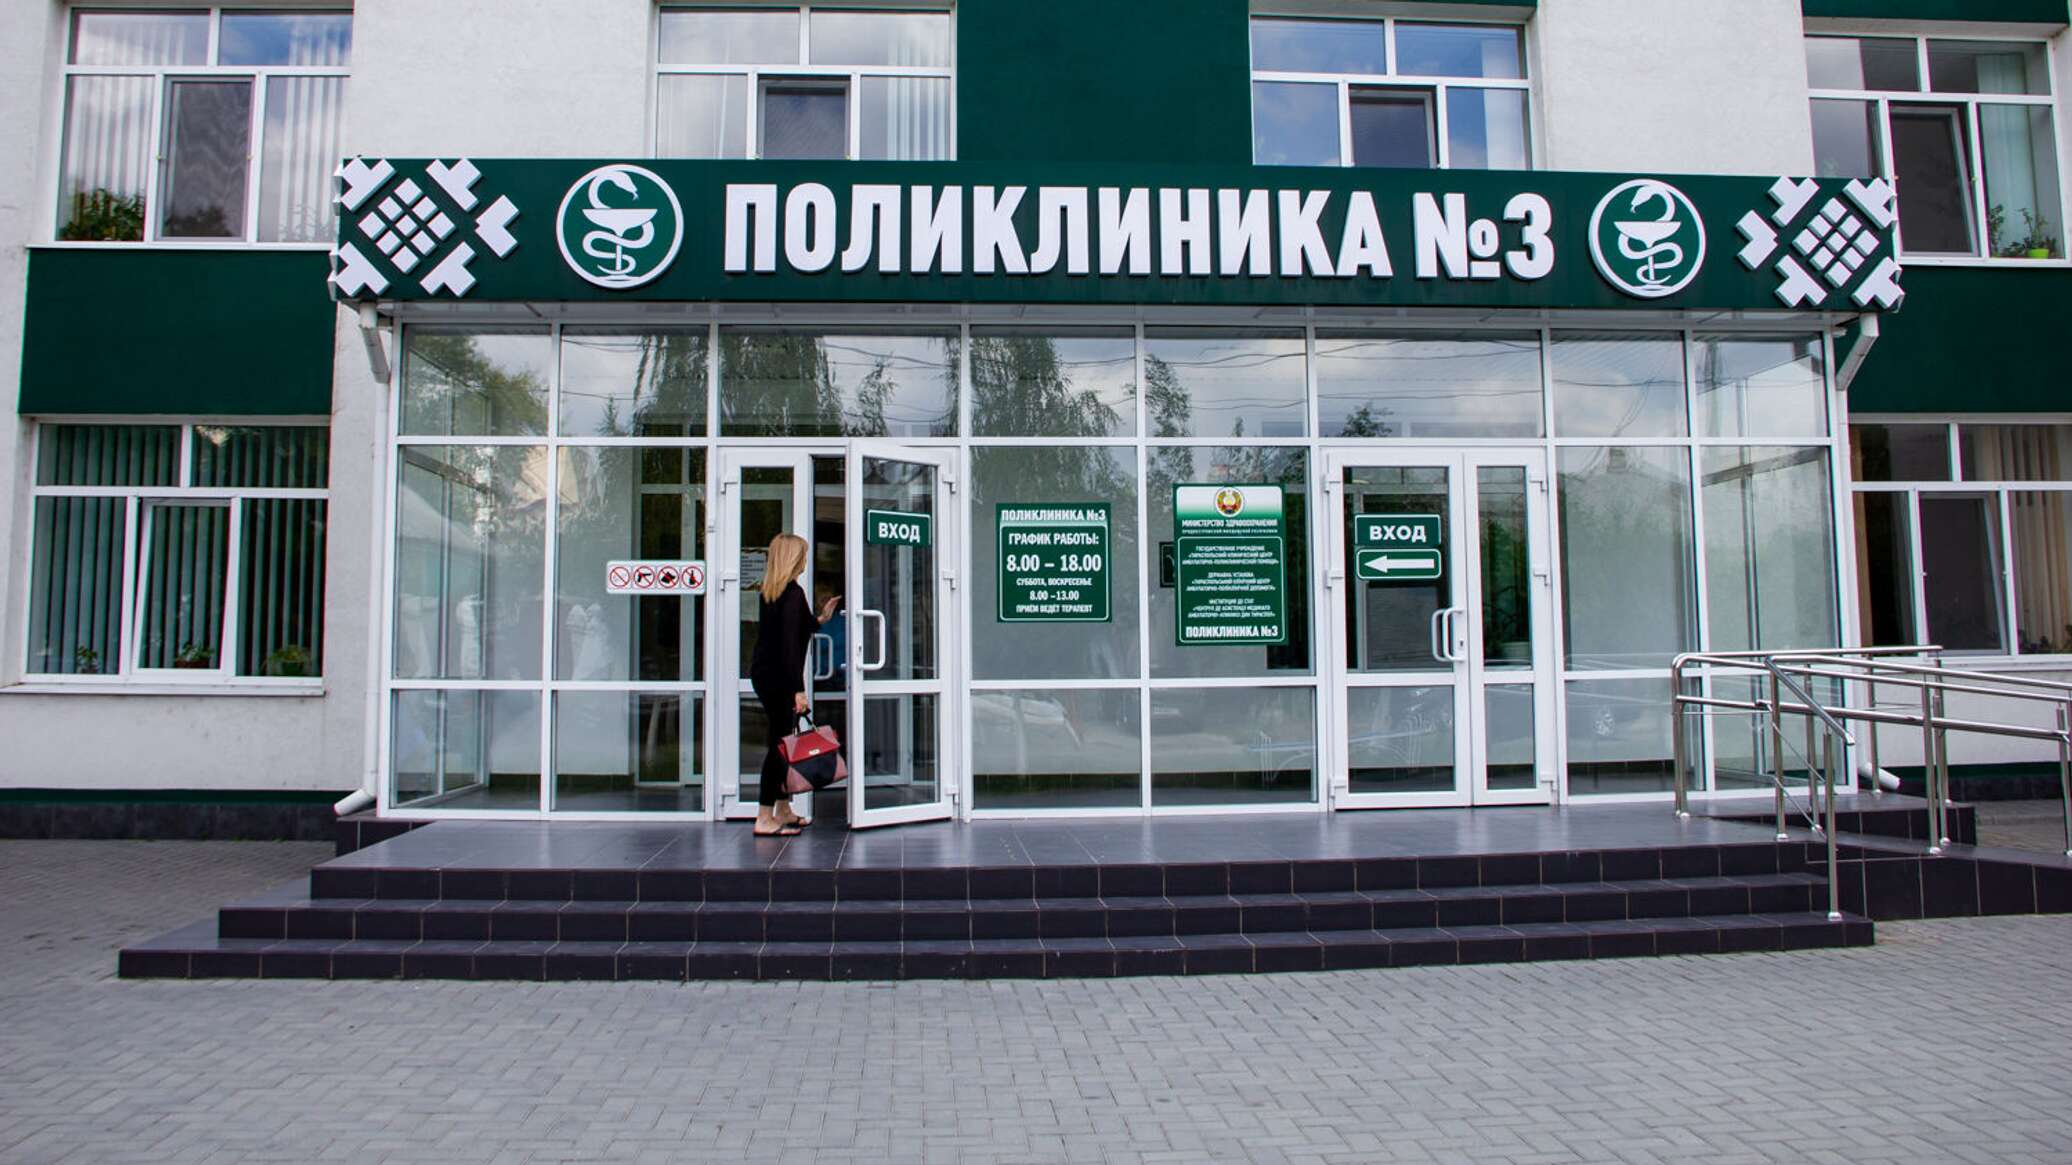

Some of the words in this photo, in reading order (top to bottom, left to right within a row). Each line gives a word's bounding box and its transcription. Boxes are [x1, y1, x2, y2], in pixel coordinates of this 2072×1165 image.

[724, 184, 1394, 276] ПОЛИКЛИНИКА
[1413, 192, 1555, 279] №3
[1001, 509, 1085, 521] ПОЛИКЛИНИКА
[1086, 509, 1106, 521] №3
[878, 522, 921, 543] ВХОД
[1008, 533, 1051, 545] ГРАФИК
[1053, 533, 1099, 545] РАБОТЫ:
[1369, 525, 1427, 543] ВХОД
[1006, 554, 1040, 572] 8.00
[1060, 554, 1102, 572] 18.00
[1048, 577, 1092, 586] ВОСКРЕСЕНЬЕ
[1029, 590, 1048, 601] 8.00
[1185, 625, 1259, 638] ПОЛИКЛИНИКА
[1260, 625, 1279, 637] №3
